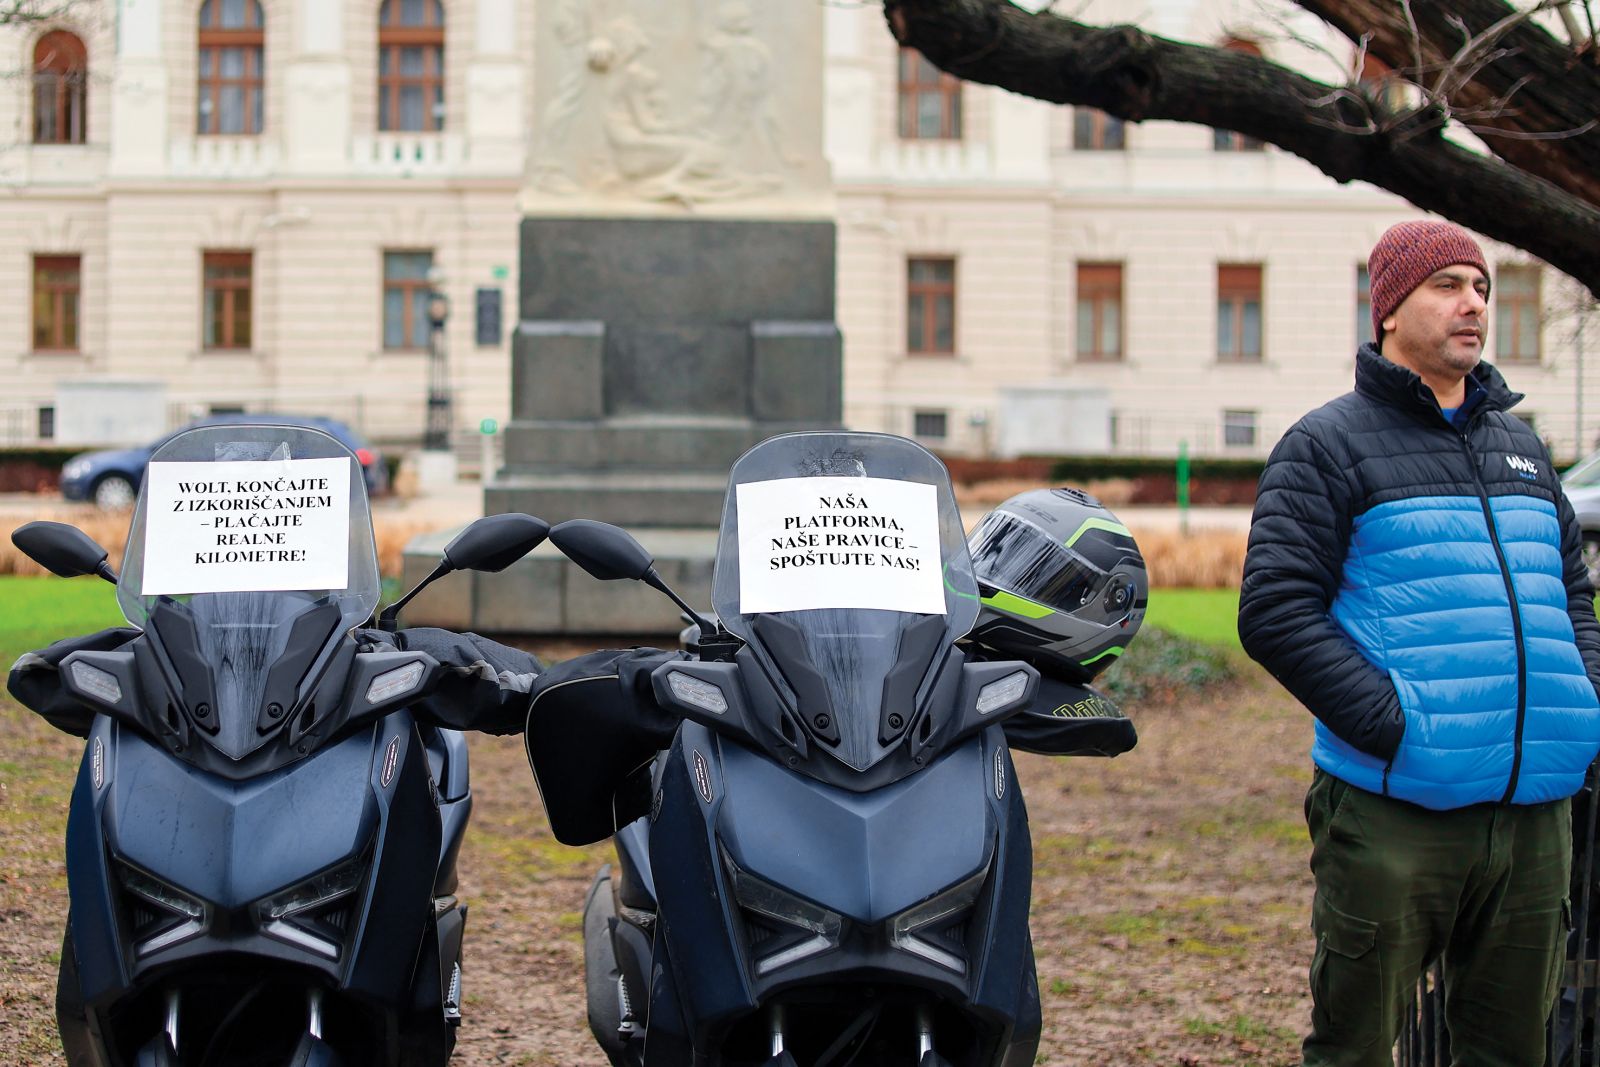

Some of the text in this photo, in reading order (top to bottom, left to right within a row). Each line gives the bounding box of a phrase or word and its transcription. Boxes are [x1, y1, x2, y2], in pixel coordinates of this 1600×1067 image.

[178, 476, 329, 493] WOLT, KONČAJTE
[173, 494, 332, 511] Z IZKORIŠČANJEM
[819, 492, 869, 508] NAŠA
[214, 512, 302, 528] PLAČAJTE
[784, 515, 904, 533] PLATFORMA,
[216, 532, 286, 545] REALNE
[771, 531, 820, 551] NAŠE
[825, 533, 905, 549] PRAVICE
[195, 549, 306, 564] KILOMETRE!
[770, 549, 920, 570] SPOŠTUJTE NAS!
